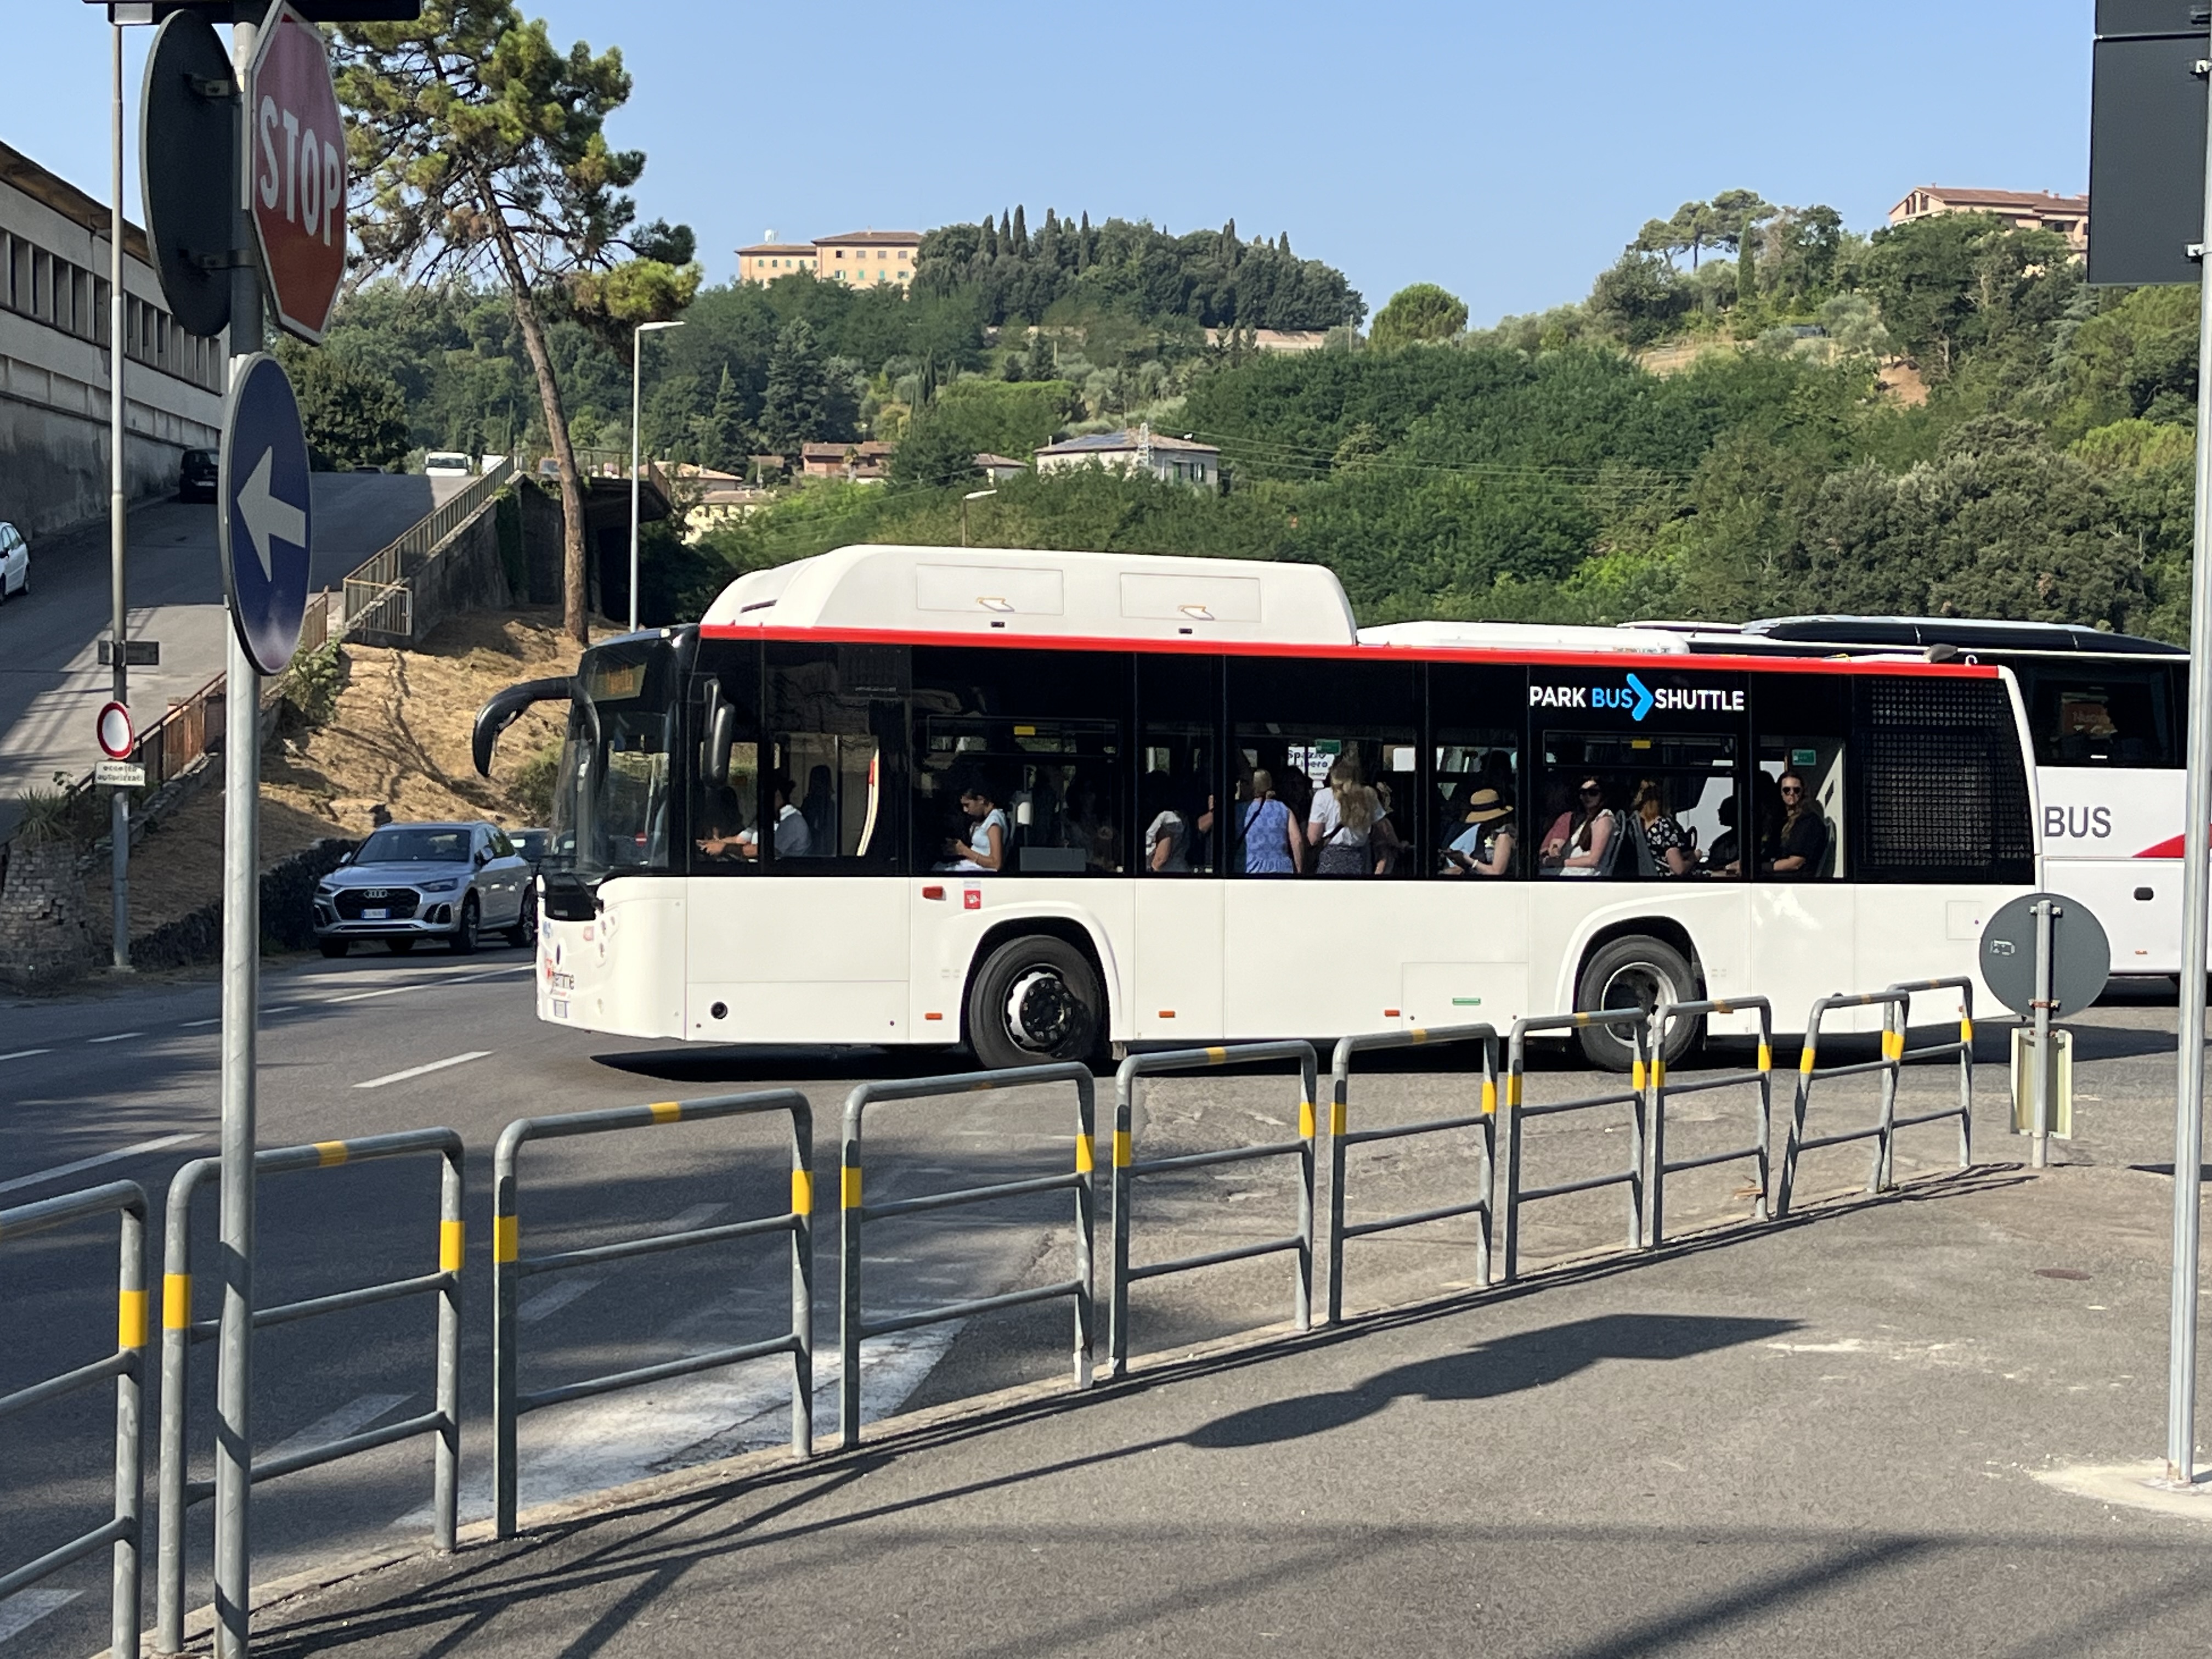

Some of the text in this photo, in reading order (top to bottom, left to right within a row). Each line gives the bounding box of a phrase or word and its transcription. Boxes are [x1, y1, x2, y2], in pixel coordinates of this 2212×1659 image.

[260, 95, 341, 246] STOP
[1530, 686, 1745, 711] PARK BUS SHUTTLE
[2044, 806, 2112, 838] BUS
